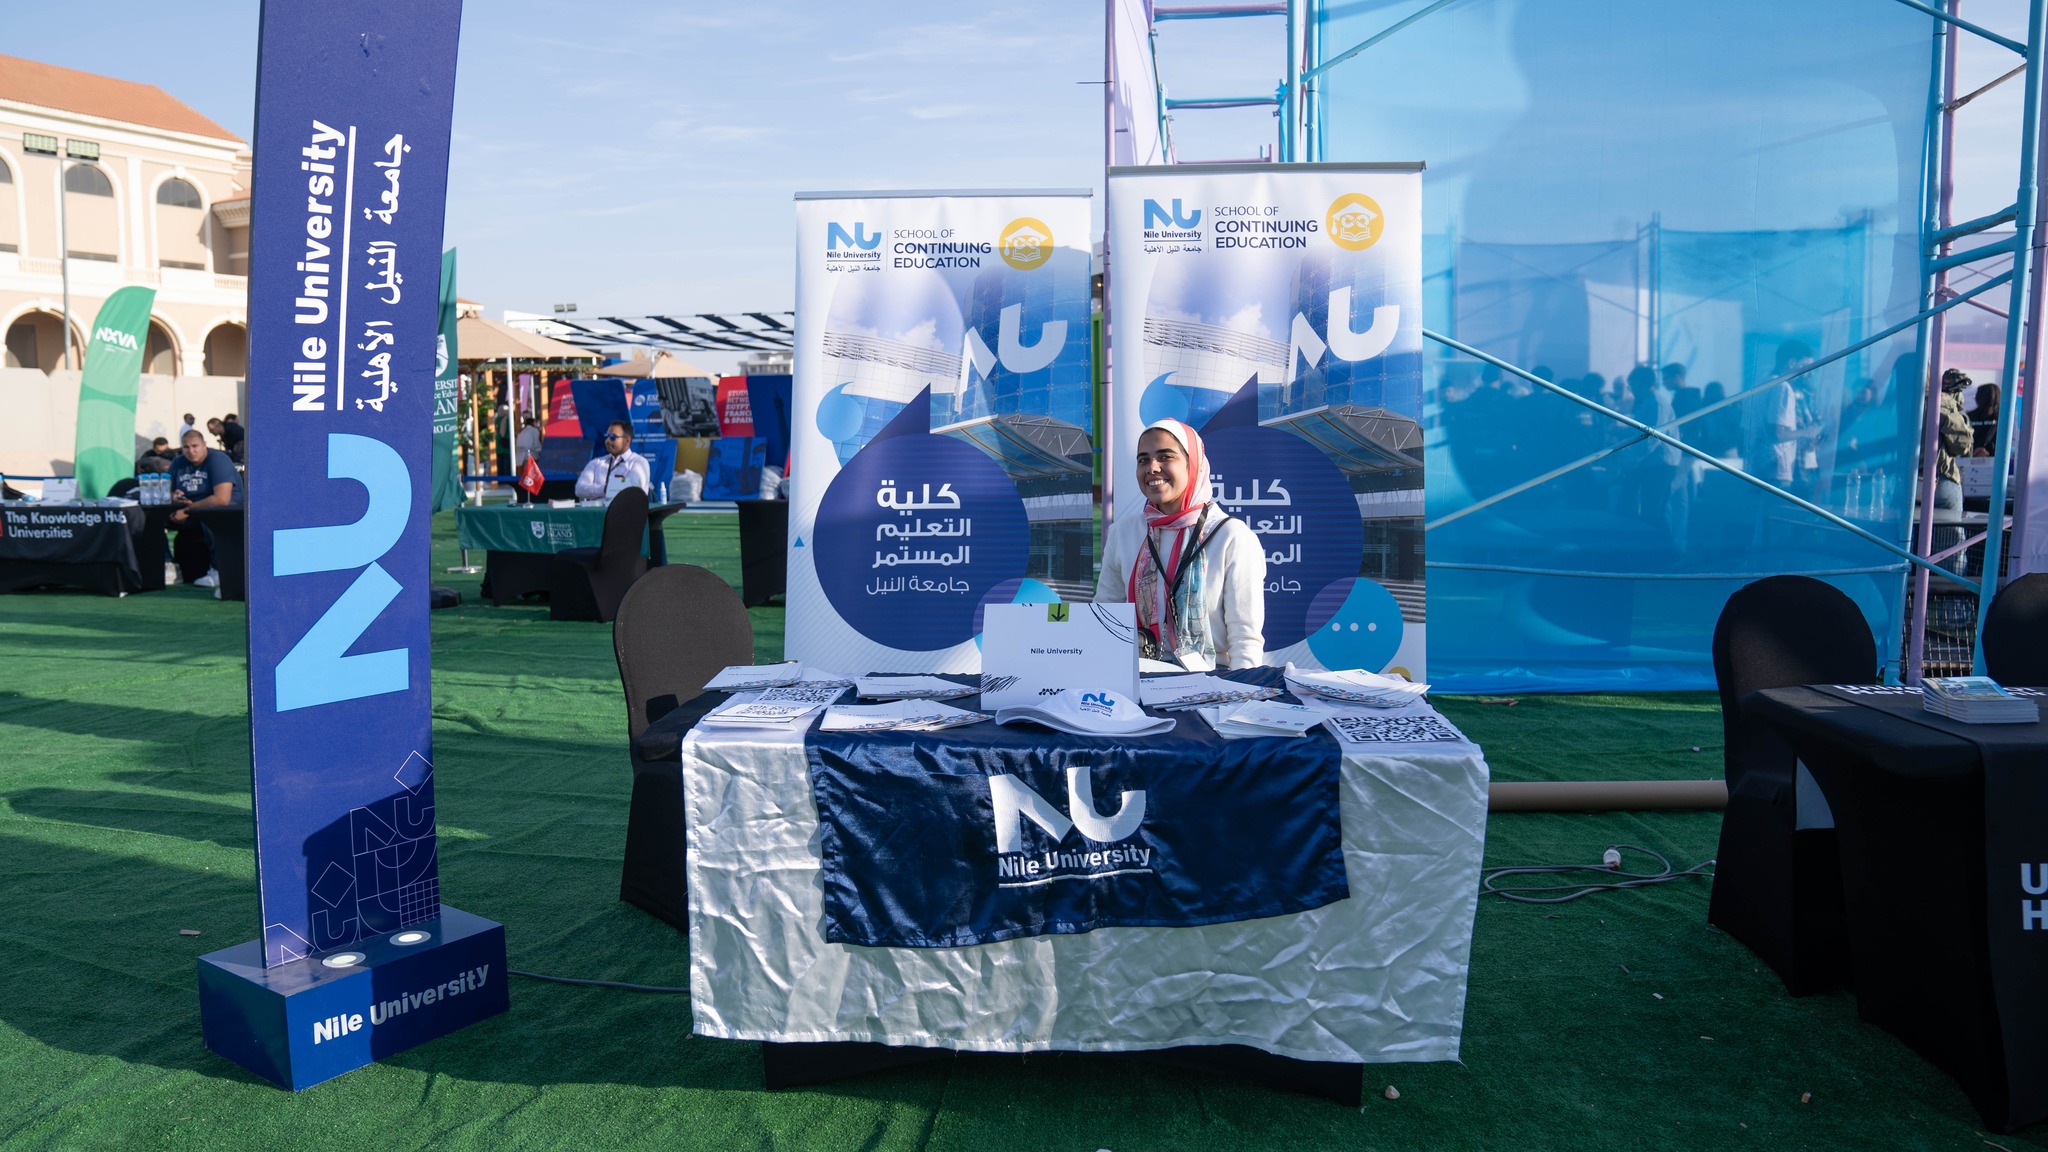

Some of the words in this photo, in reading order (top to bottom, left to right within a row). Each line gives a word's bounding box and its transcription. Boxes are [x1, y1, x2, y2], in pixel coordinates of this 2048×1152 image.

[364, 133, 411, 225] جامعة
[1144, 198, 1201, 229] NU
[1215, 206, 1261, 216] SCHOOL
[1264, 206, 1279, 216] OF
[295, 119, 345, 324] University
[1215, 220, 1318, 233] CONTINUING
[827, 222, 882, 250] NU
[894, 229, 938, 238] SCHOOL
[940, 228, 955, 238] OF
[1161, 230, 1202, 240] University
[1216, 236, 1307, 248] EDUCATION
[843, 251, 881, 259] University
[894, 242, 991, 254] CONTINUING
[1183, 245, 1202, 253] جامعة
[365, 240, 403, 305] النيل
[894, 257, 980, 268] EDUCATION
[293, 336, 327, 411] Nile
[356, 320, 398, 412] الأهلية
[435, 379, 458, 390] ERSIT
[877, 480, 961, 516] كلية
[5, 511, 28, 524] The
[30, 511, 102, 527] Knowledge
[104, 511, 128, 524] Hub
[1246, 515, 1302, 534] التعل
[8, 525, 74, 538] Universities
[876, 518, 971, 541] التعليم
[872, 546, 970, 568] المستمر
[866, 576, 905, 595] النيل
[909, 575, 970, 594] جامعة
[988, 766, 1146, 853] NU
[998, 856, 1039, 877] Nile
[1045, 844, 1150, 870] University
[2021, 863, 2048, 895] U
[2022, 899, 2048, 930] H
[313, 1013, 363, 1045] Nile
[370, 963, 490, 1026] University
